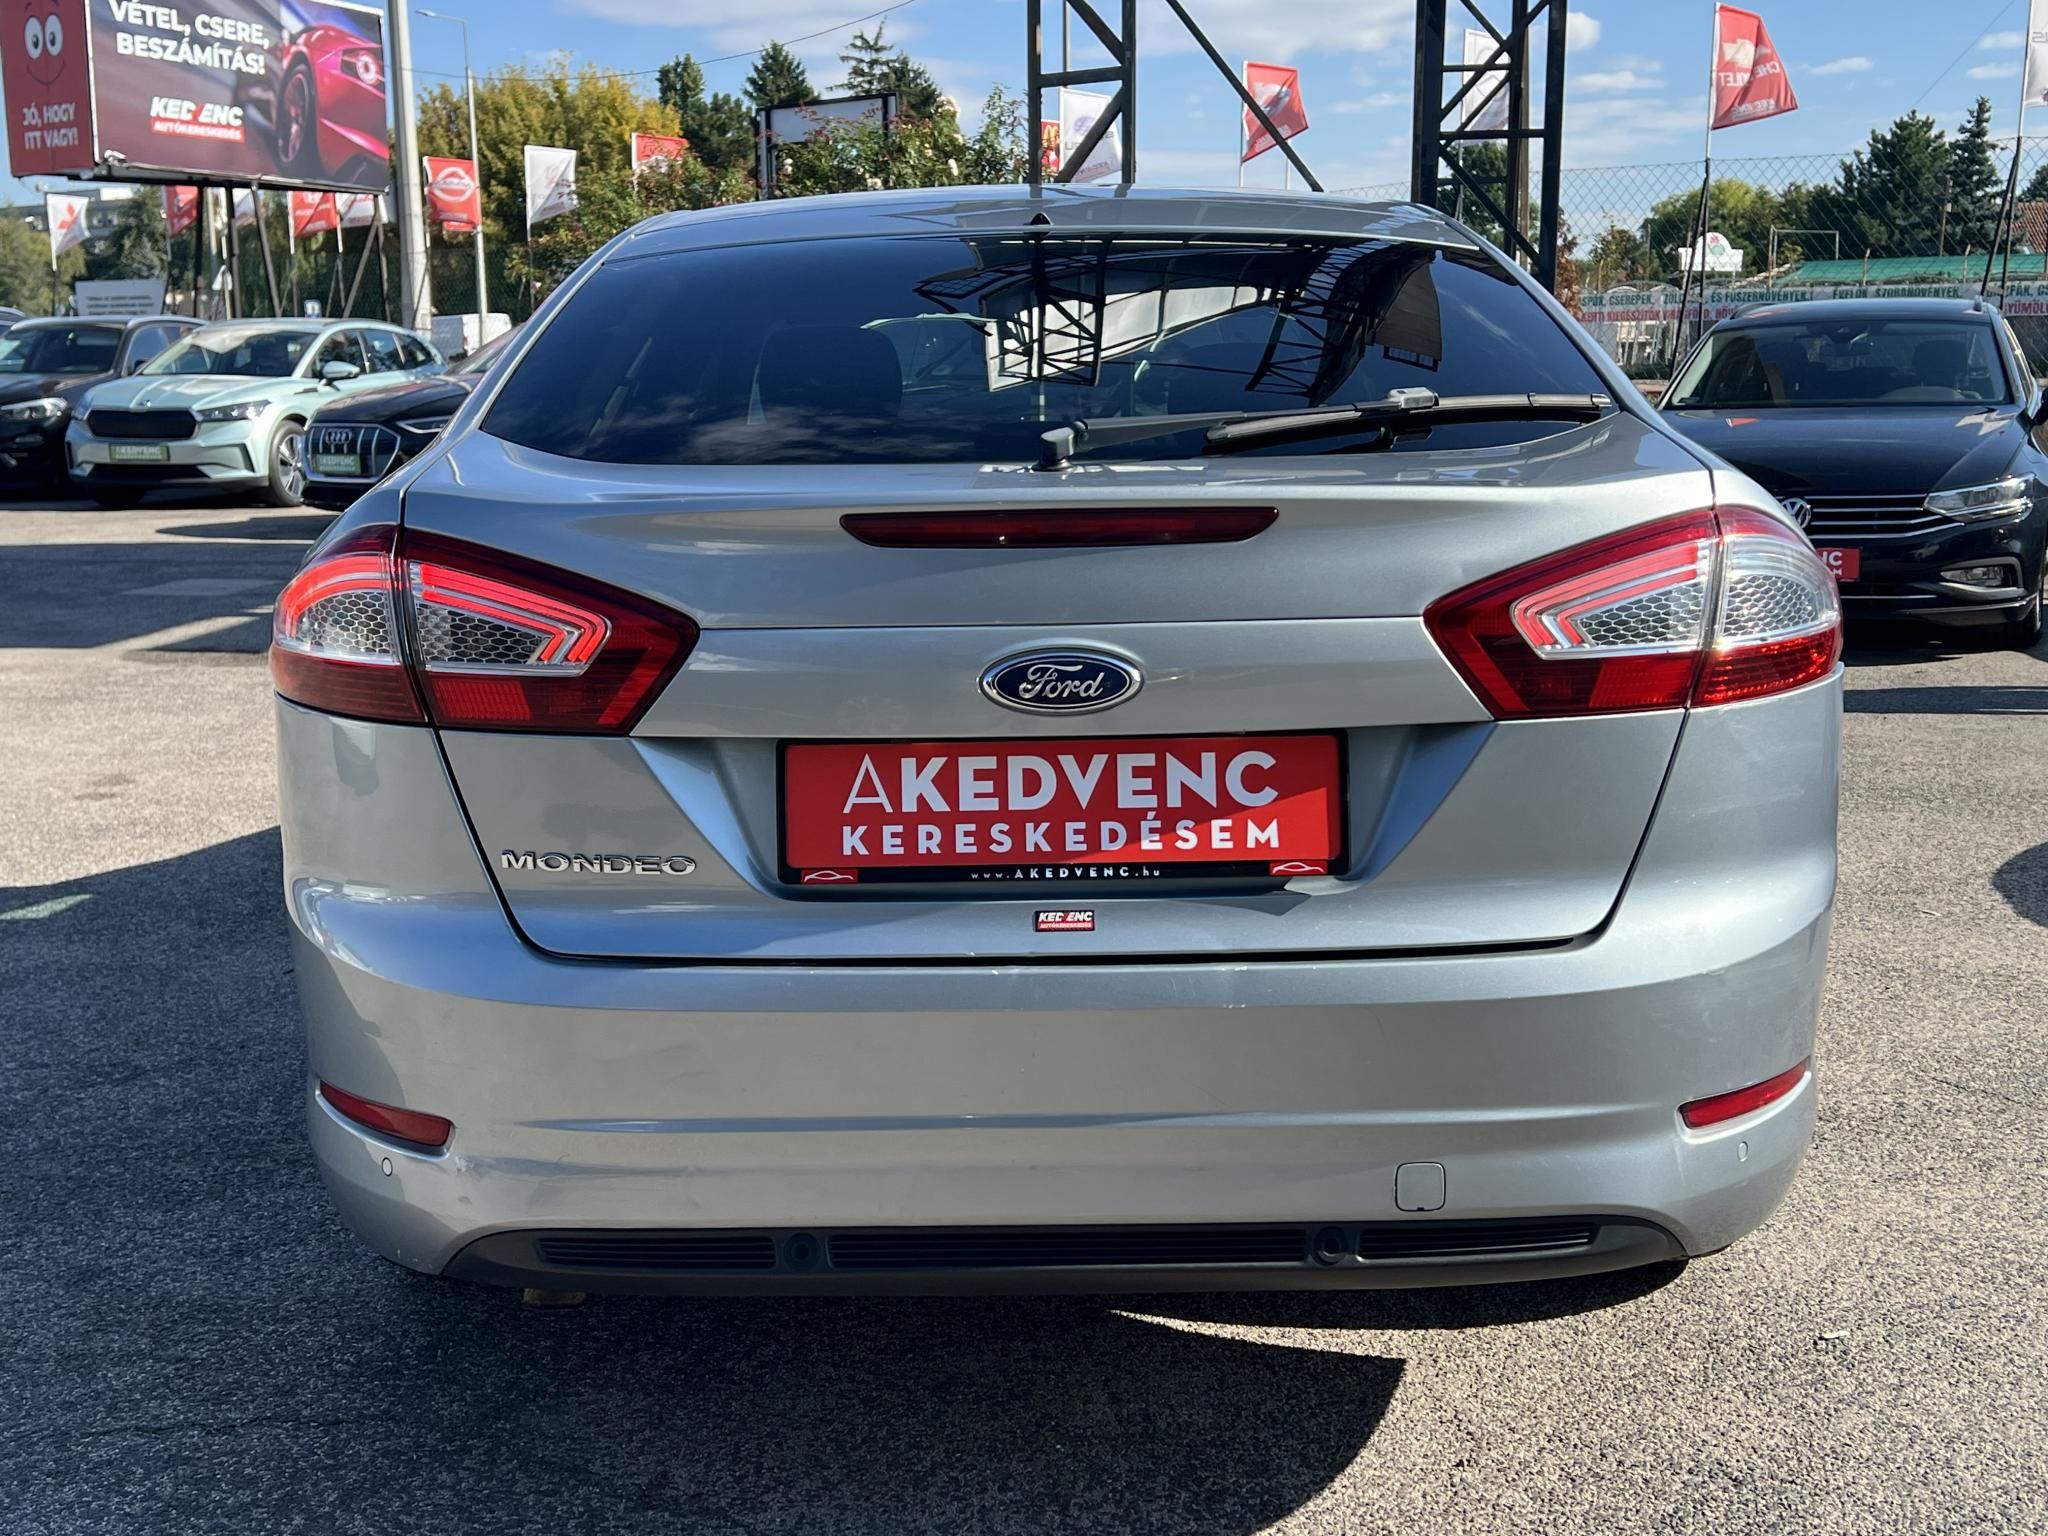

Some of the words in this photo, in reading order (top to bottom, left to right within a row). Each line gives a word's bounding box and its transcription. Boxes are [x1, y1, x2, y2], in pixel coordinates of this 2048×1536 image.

[108, 0, 191, 36] VÉTEL,
[195, 14, 269, 49] CSERE,
[116, 32, 265, 75] BESZÁMÍTÁS!
[23, 101, 42, 128] JÓ,
[43, 102, 76, 125] HOGY
[24, 130, 41, 150] ITT
[43, 126, 78, 149] VAGY!
[1019, 664, 1104, 699] Ford
[842, 812, 1280, 856] KERESKEDÉSEM
[501, 850, 698, 876] MONDEO
[971, 866, 1160, 879] www.AKEDVENC.hu
